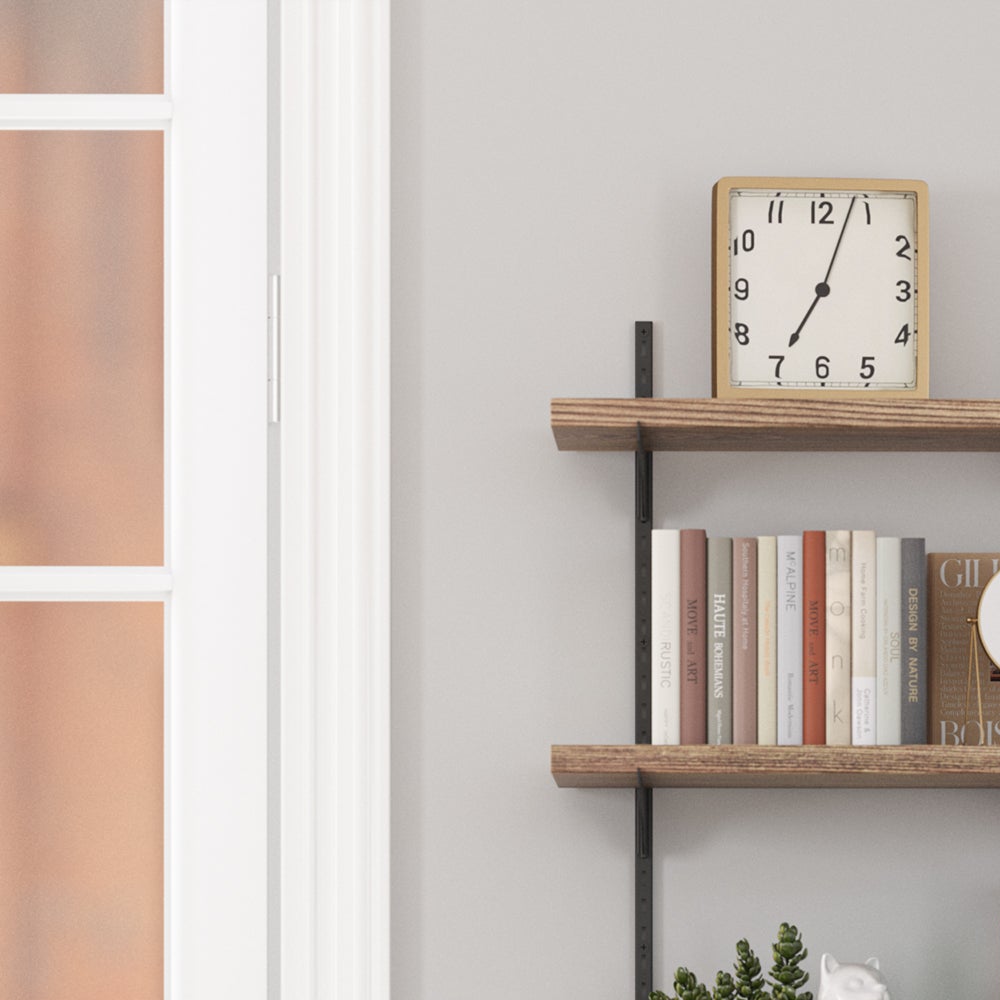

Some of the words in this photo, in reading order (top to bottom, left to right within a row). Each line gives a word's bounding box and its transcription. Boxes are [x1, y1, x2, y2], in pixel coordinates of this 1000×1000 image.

[768, 200, 784, 224] 11
[811, 201, 835, 224] 12
[862, 201, 871, 225] 1
[734, 229, 755, 256] 10
[895, 235, 912, 260] 2
[734, 278, 749, 301] 9
[895, 280, 911, 302] 3
[734, 322, 750, 346] 8
[894, 323, 911, 346] 4
[768, 355, 785, 378] 7
[815, 356, 830, 379] 6
[859, 356, 875, 379] 5
[741, 542, 750, 577] Southern
[859, 562, 868, 585] Home
[859, 586, 868, 607] Farm
[687, 599, 698, 636] MOVE
[714, 593, 726, 638] HAUTE
[808, 600, 819, 637] MOVE
[908, 588, 919, 632] DESIGN
[858, 609, 868, 640] Cooking
[741, 628, 750, 650] Home
[890, 631, 900, 663] SOUL
[908, 636, 919, 652] BY
[660, 641, 672, 689] RUSTIC
[687, 659, 698, 685] ART
[713, 642, 724, 699] BOHEMIANS
[808, 660, 819, 685] ART
[908, 657, 919, 703] NATURE
